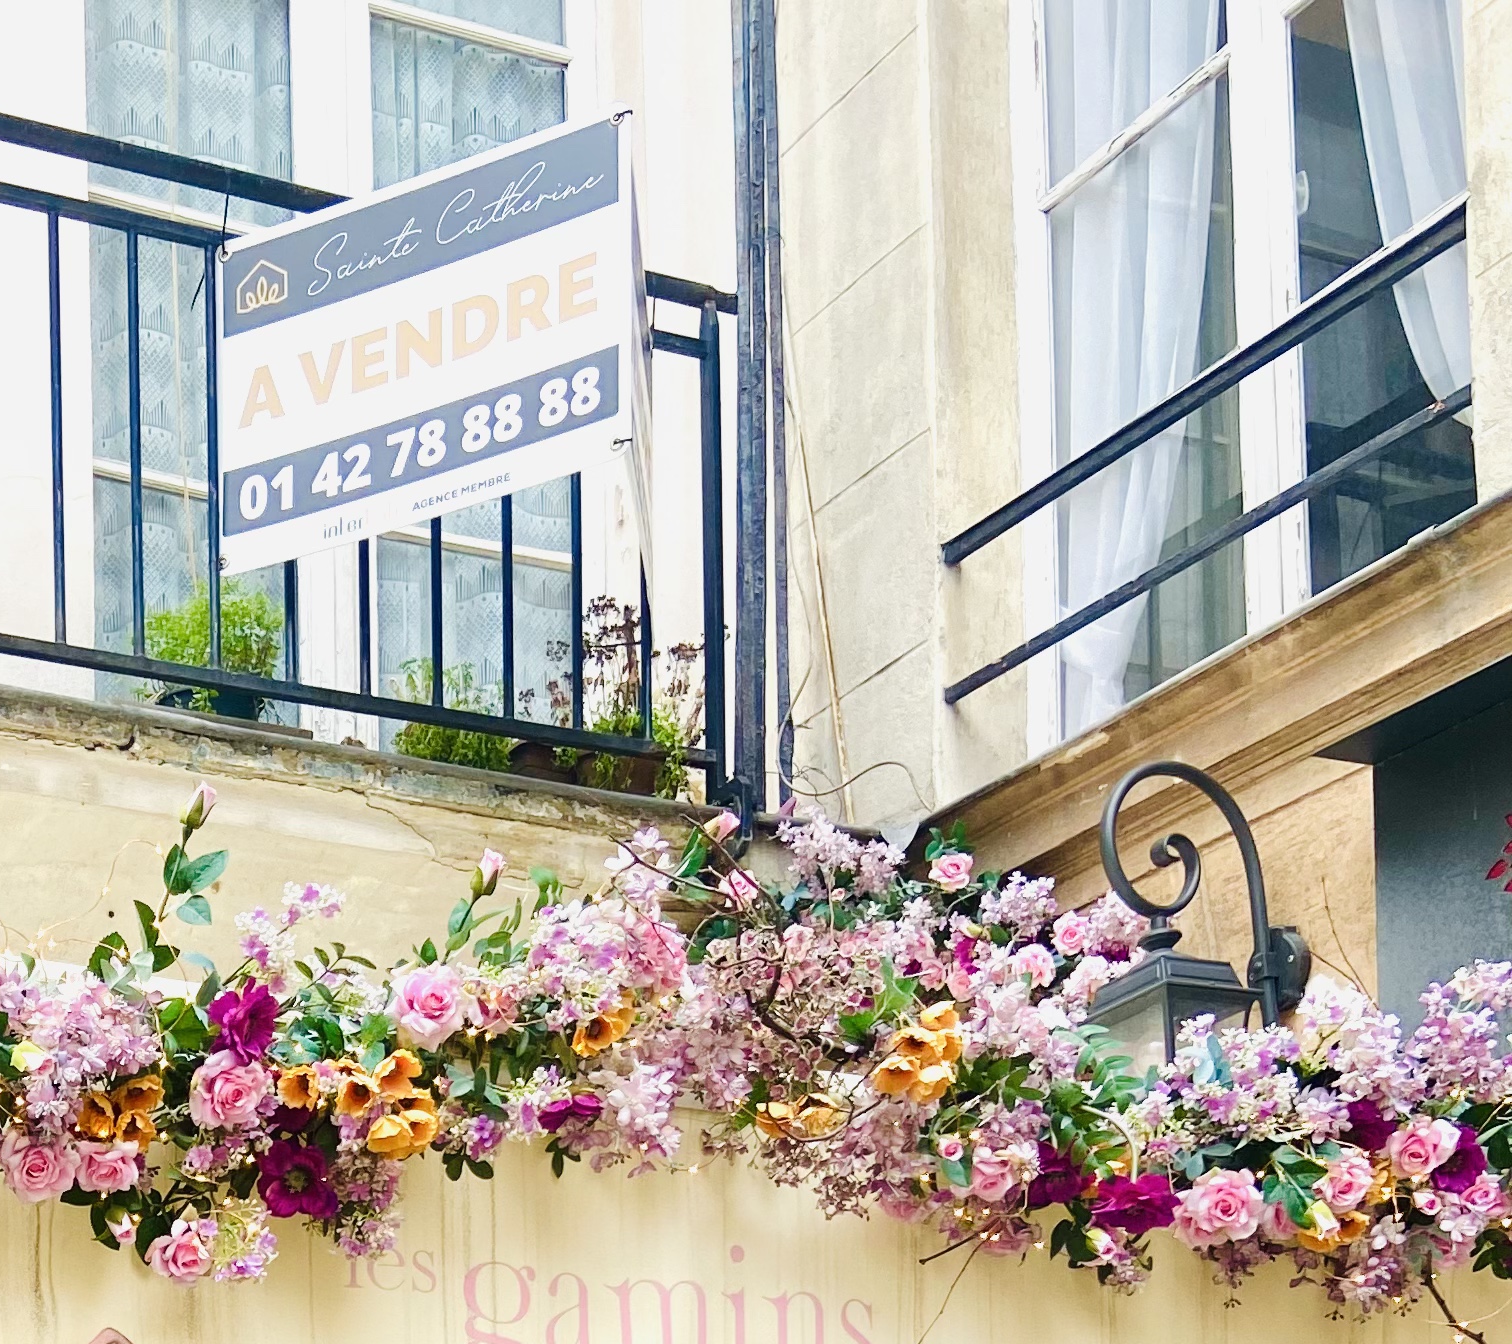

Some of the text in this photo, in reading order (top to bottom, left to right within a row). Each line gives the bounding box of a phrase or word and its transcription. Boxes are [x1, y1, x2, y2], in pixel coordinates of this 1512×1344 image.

[308, 161, 604, 297] Sainte Catherine
[238, 252, 598, 430] A VENDRE
[239, 367, 601, 520] 01 42 78 88 88
[412, 489, 459, 512] AGENCE
[460, 472, 511, 497] MEMBRE
